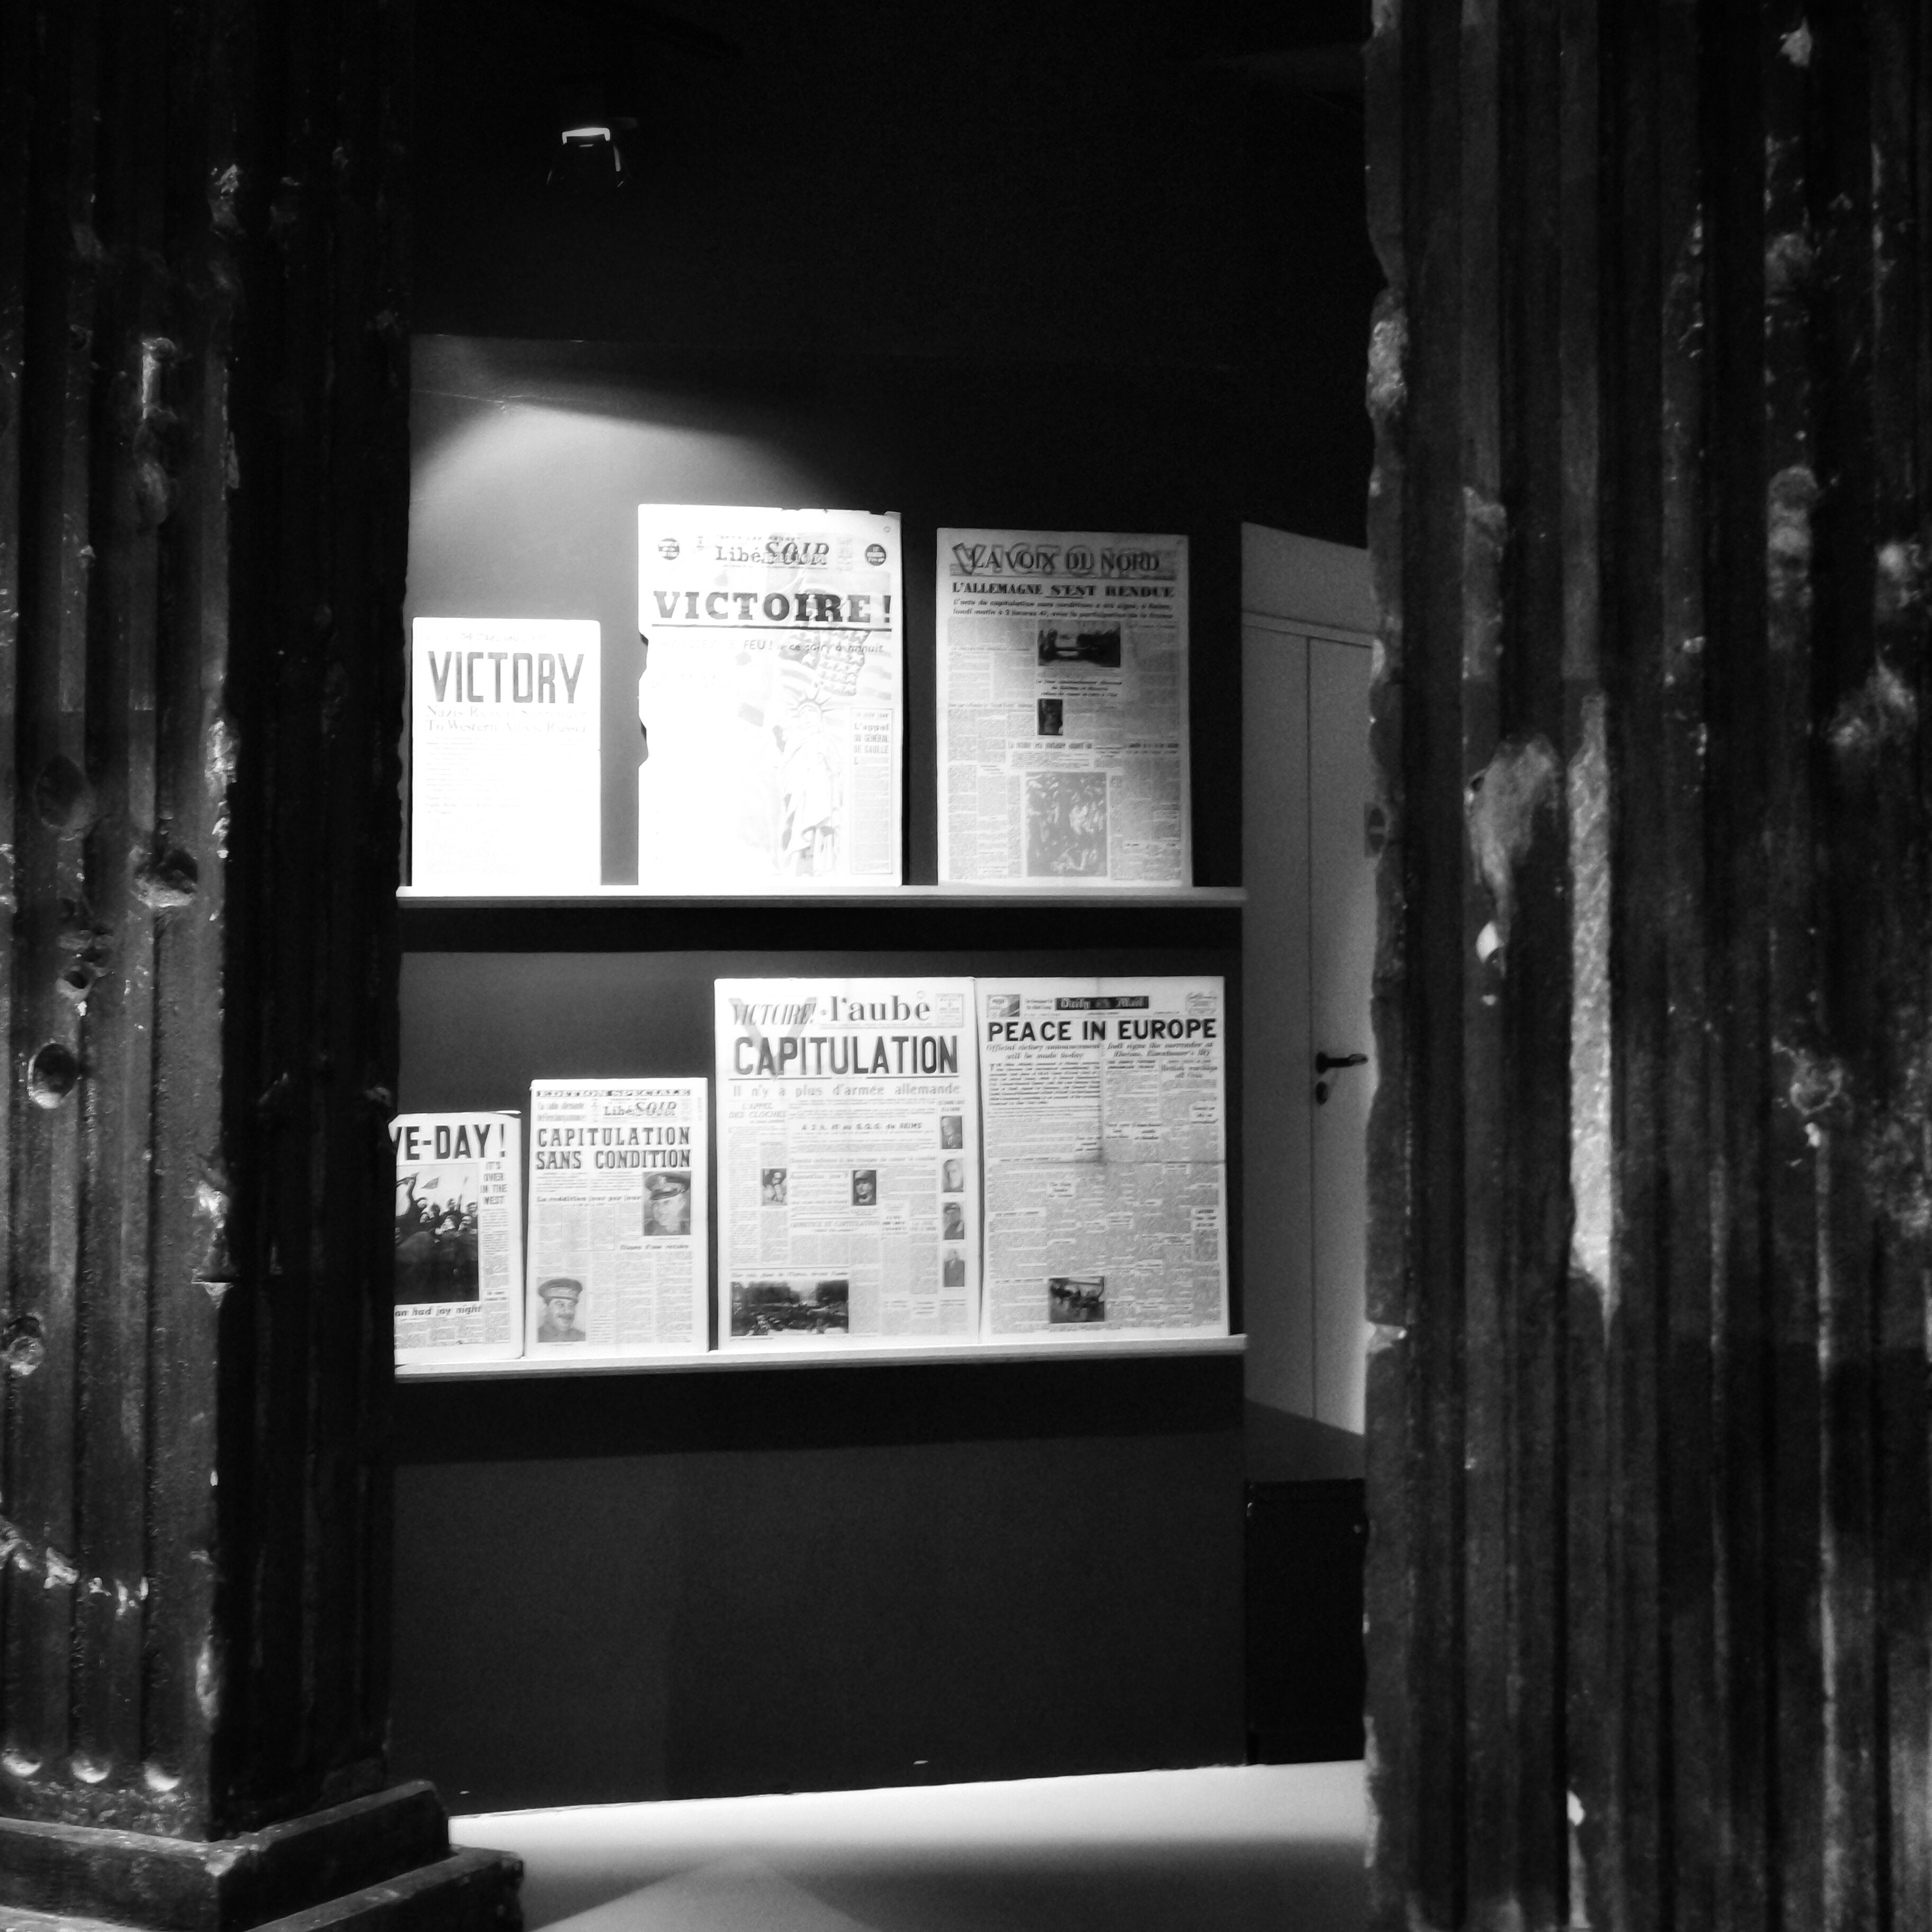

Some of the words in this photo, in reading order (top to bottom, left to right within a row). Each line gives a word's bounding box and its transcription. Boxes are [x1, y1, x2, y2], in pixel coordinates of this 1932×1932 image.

[1006, 551, 1058, 570] VOIX
[1101, 552, 1160, 571] NORD
[952, 582, 1043, 594] L'ALLEMAGNE
[1050, 585, 1096, 596] S'EST
[1105, 586, 1175, 597] RENDUE
[427, 650, 585, 704] VICTORY
[426, 705, 463, 718] Nazis
[426, 719, 444, 731] To
[448, 719, 497, 731] Western
[830, 995, 932, 1022] l'aube
[988, 1021, 1071, 1041] PEACE
[1082, 1020, 1106, 1041] IN
[1117, 1018, 1217, 1040] EUROPE
[734, 1035, 958, 1076] CAPITULATION
[795, 1084, 822, 1098] plus
[895, 1083, 961, 1095] allemande
[538, 1126, 691, 1147] CAPITULATION
[536, 1151, 582, 1170] SANS
[595, 1149, 691, 1169] CONDITION
[484, 1172, 504, 1182] OVER
[484, 1195, 505, 1205] WEST
[412, 1306, 433, 1316] had
[455, 1304, 482, 1315] night
